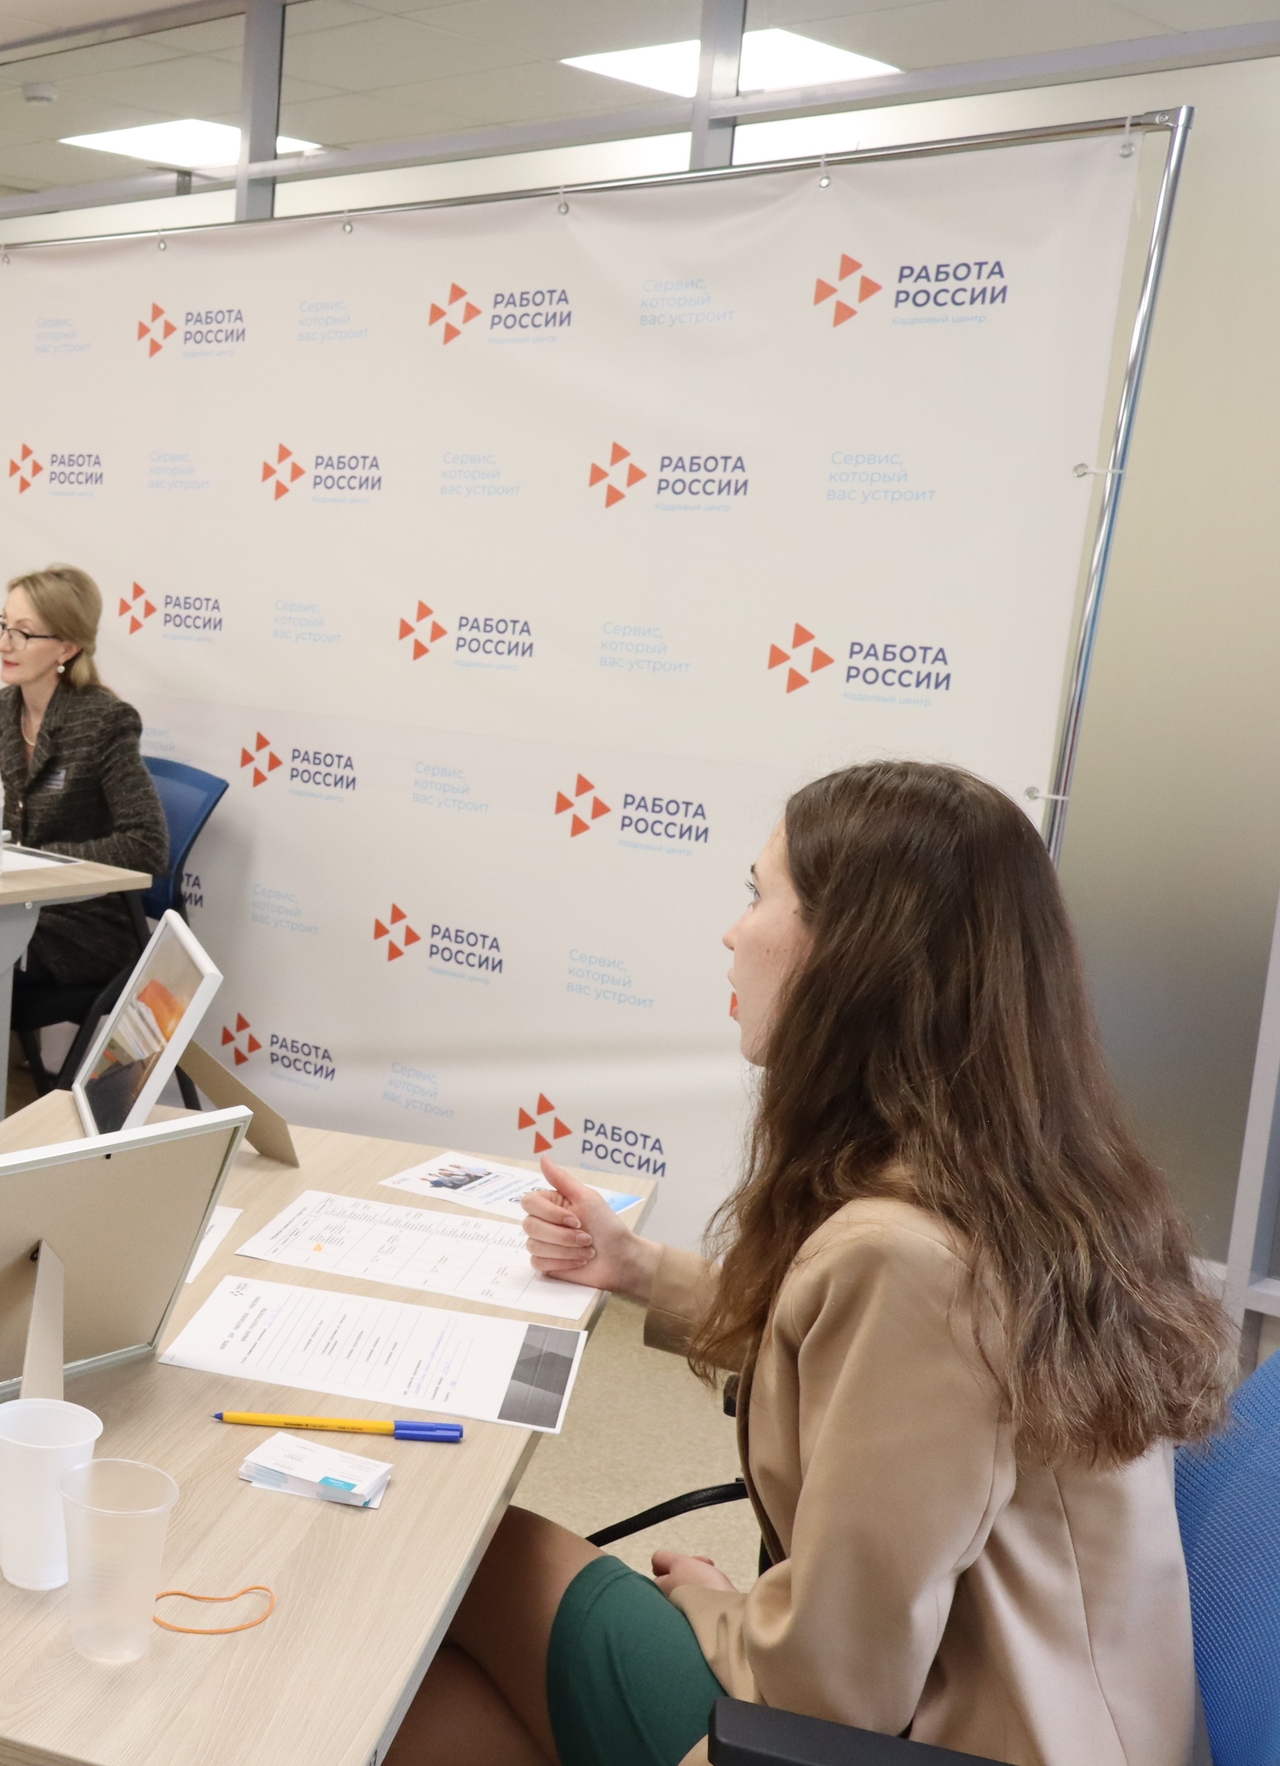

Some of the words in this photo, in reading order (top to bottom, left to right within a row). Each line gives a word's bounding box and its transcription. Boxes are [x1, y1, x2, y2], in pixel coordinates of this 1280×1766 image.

[898, 261, 1004, 283] РАБОТА
[494, 289, 569, 308] РАБОТА
[641, 293, 711, 309] который
[895, 286, 1007, 307] РОССИИ
[185, 310, 243, 325] РАБОТА
[298, 312, 350, 327] который
[491, 311, 571, 329] РОССИИ
[640, 311, 665, 325] вас
[670, 309, 735, 327] устроит
[952, 314, 986, 324] центр
[184, 328, 245, 344] РОССИИ
[297, 328, 319, 341] вас
[320, 326, 369, 342] устроит
[51, 454, 101, 467] РАБОТА
[315, 456, 379, 470] РАБОТА
[660, 456, 745, 472] РАБОТА
[50, 471, 103, 484] РОССИИ
[313, 475, 381, 490] РОССИИ
[441, 468, 500, 481] который
[829, 468, 908, 485] который
[440, 484, 462, 495] вас
[467, 484, 520, 498] устроит
[657, 479, 748, 495] РОССИИ
[826, 488, 857, 501] вас
[862, 489, 937, 505] устроит
[165, 595, 220, 612] РАБОТА
[164, 613, 222, 630] РОССИИ
[274, 614, 324, 629] который
[459, 616, 531, 636] РАБОТА
[273, 629, 291, 641] вас
[295, 631, 342, 644] устроит
[456, 637, 533, 657] РОССИИ
[601, 639, 667, 655] который
[849, 642, 947, 665] РАБОТА
[599, 657, 622, 669] вас
[627, 658, 691, 675] устроит
[846, 666, 951, 690] РОССИИ
[899, 695, 932, 707] центр
[292, 749, 353, 770] РАБОТА
[290, 768, 356, 790] РОССИИ
[413, 777, 470, 795] который
[412, 793, 433, 806] вас
[436, 796, 489, 814] устроит
[624, 794, 706, 820] РАБОТА
[621, 816, 708, 843] РОССИИ
[430, 924, 501, 953] РАБОТА
[430, 944, 502, 973] РОССИИ
[567, 968, 632, 989] который
[565, 984, 589, 997] вас
[593, 988, 654, 1010] устроит
[270, 1034, 333, 1062] РАБОТА
[270, 1052, 336, 1081] РОССИИ
[583, 1118, 664, 1155] РАБОТА
[581, 1139, 666, 1177] РОССИИ
